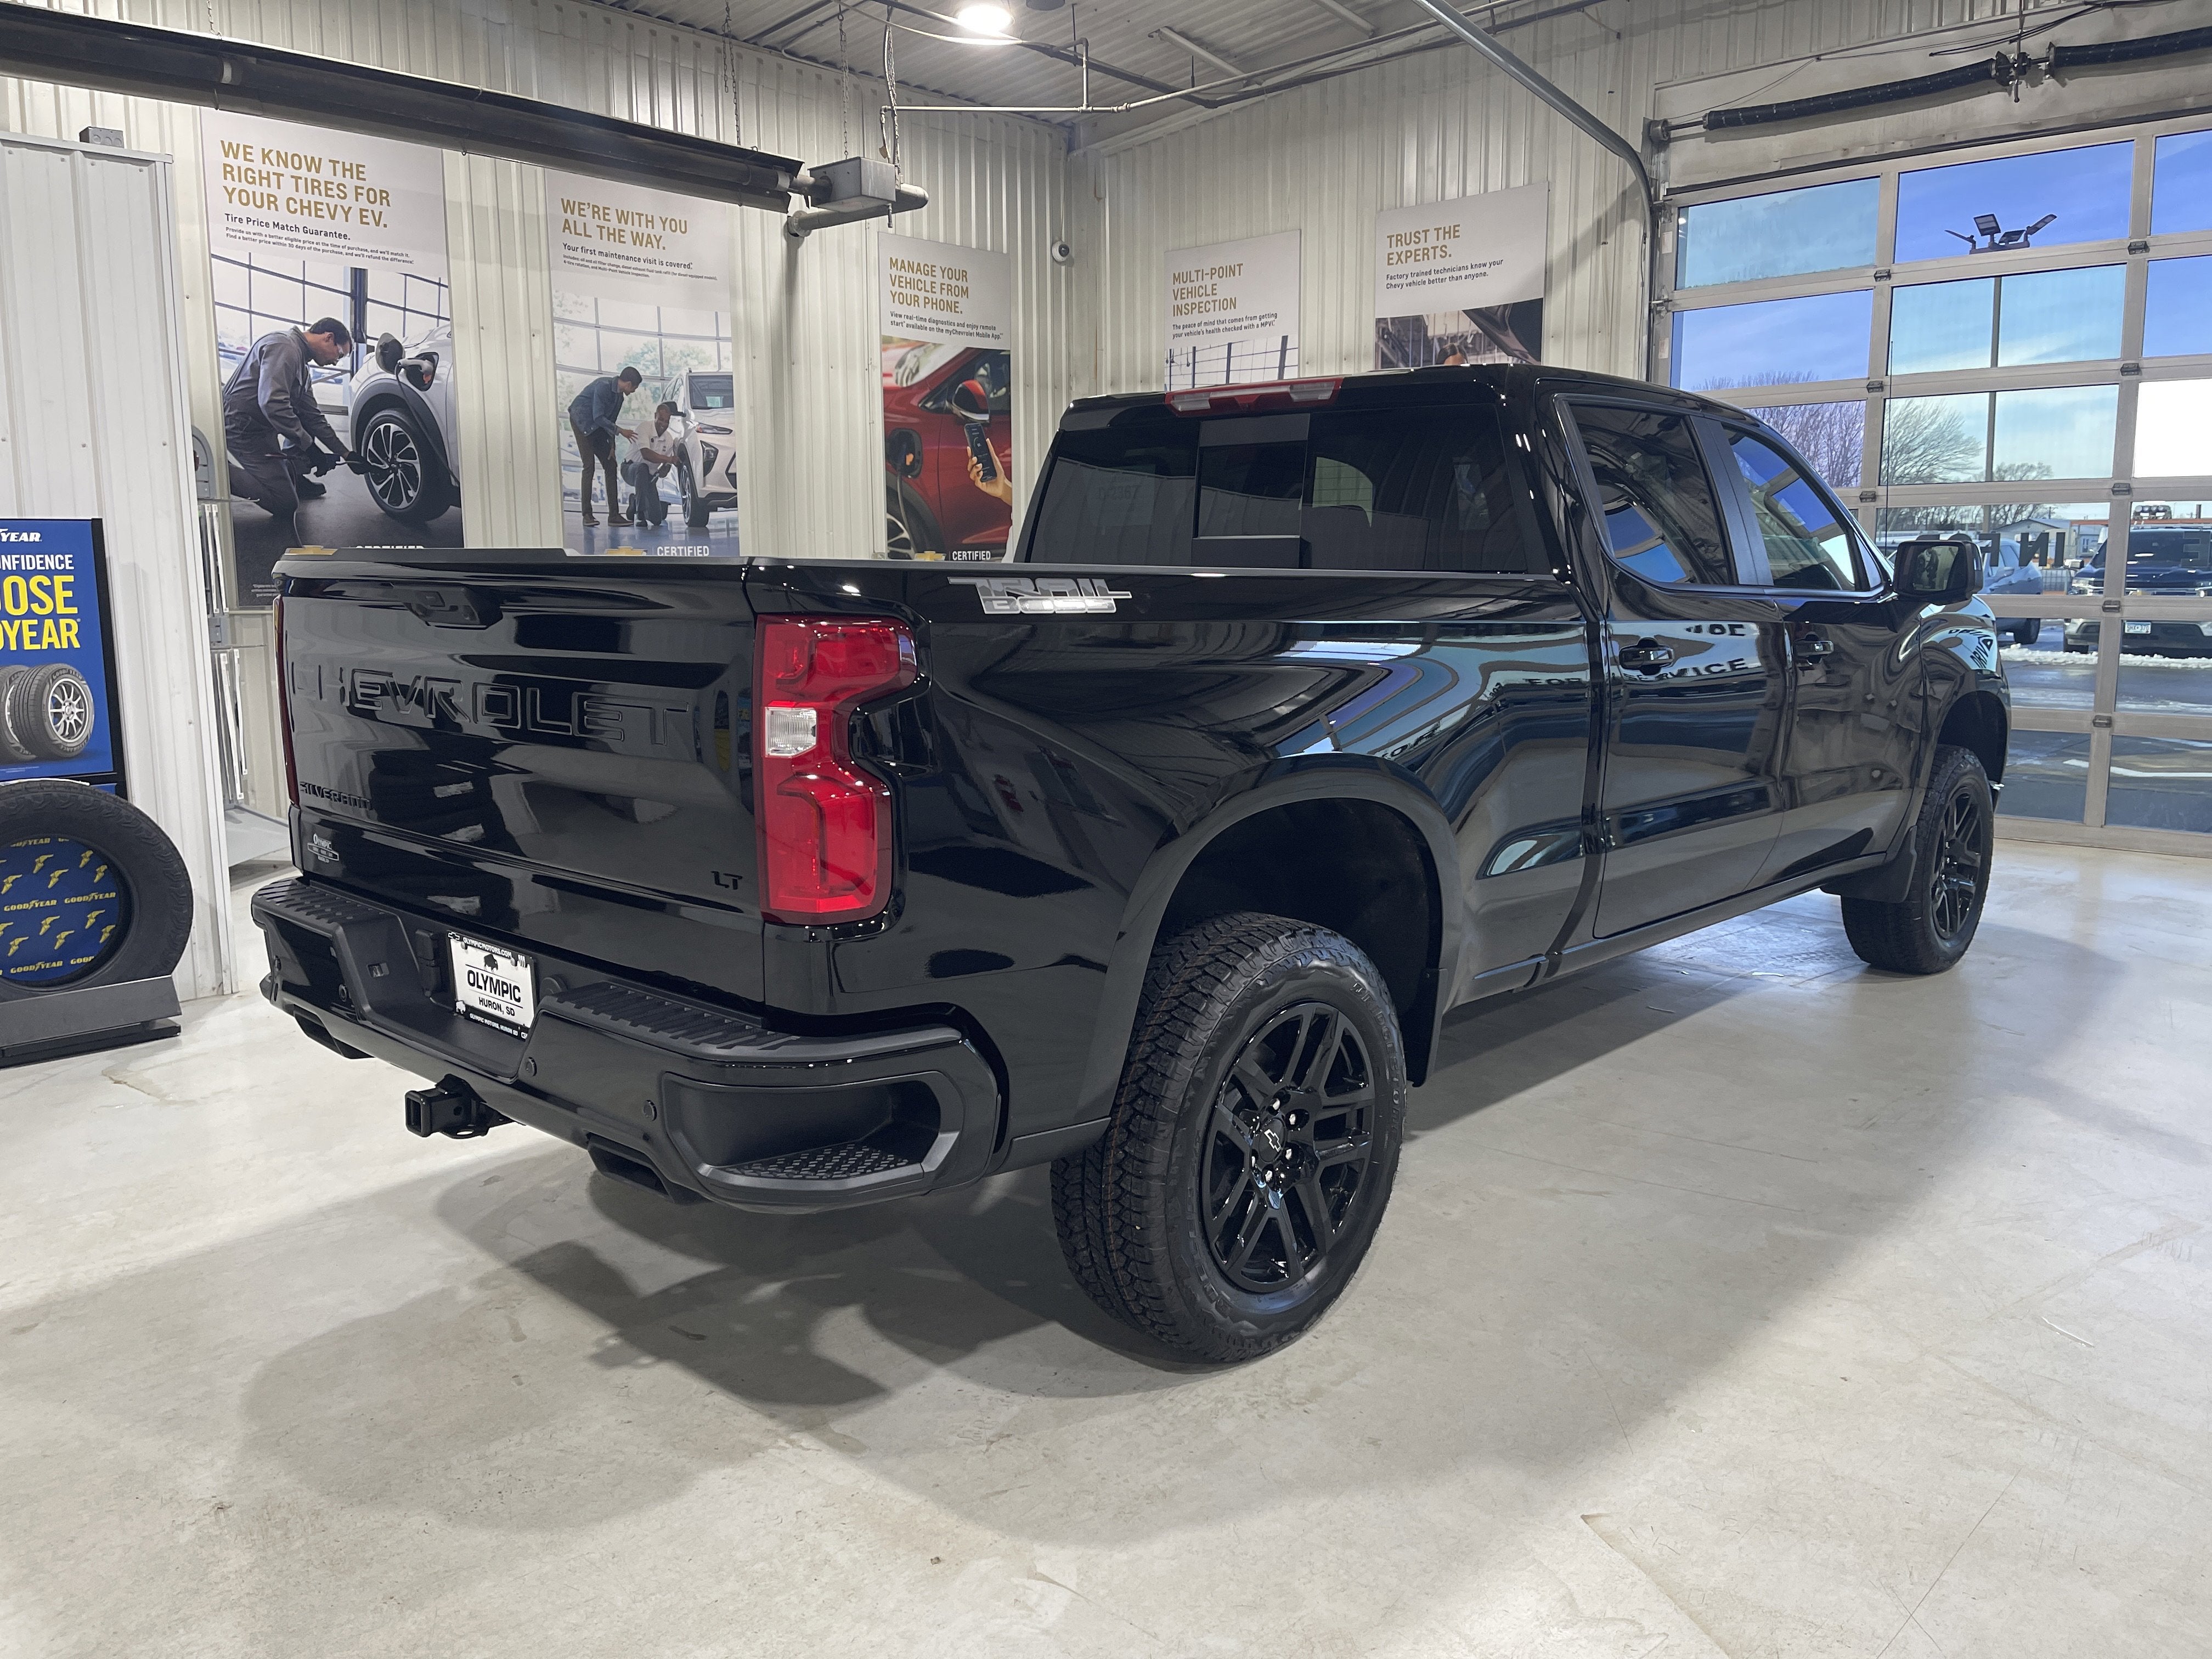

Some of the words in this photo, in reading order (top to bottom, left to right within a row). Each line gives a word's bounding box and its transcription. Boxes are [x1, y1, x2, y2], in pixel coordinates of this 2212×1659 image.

[221, 140, 254, 163] WE
[262, 148, 322, 174] KNOW
[329, 159, 366, 182] THE
[223, 163, 284, 190] RIGHT
[291, 175, 347, 201] TIRES
[354, 187, 391, 207] FOR
[223, 185, 279, 212] YOUR
[286, 196, 352, 223] CHEVY
[359, 208, 387, 228] EV.
[561, 198, 611, 222] WE'RE
[615, 208, 654, 229] WITH
[659, 216, 687, 234] YOU
[224, 213, 243, 223] Tire
[247, 217, 269, 228] Price
[273, 221, 300, 233] Match
[303, 226, 350, 240] Guarantee.
[562, 218, 592, 238] ALL
[596, 224, 626, 244] THE
[630, 231, 665, 250] WAY.
[1387, 229, 1430, 248] TRUST
[1434, 224, 1460, 241] THE
[563, 242, 579, 252] Your
[581, 246, 596, 256] first
[598, 251, 641, 262] maintenance
[1387, 245, 1452, 266] EXPERTS.
[889, 257, 936, 278] MANAGE
[940, 266, 968, 283] YOUR
[1173, 263, 1243, 285] MULTI-POINT
[1410, 269, 1432, 278] trained
[1434, 264, 1469, 274] technicians
[1489, 259, 1504, 268] your
[889, 274, 936, 294] VEHICLE
[940, 283, 969, 299] FROM
[1386, 281, 1404, 289] Chevy
[1406, 279, 1426, 287] vehicle
[1428, 276, 1447, 285] better
[1465, 272, 1488, 280] anyone.
[890, 290, 919, 308] YOUR
[924, 296, 962, 314] PHONE.
[1173, 283, 1217, 301] VEHICLE
[1173, 297, 1237, 317] INSPECTION
[1259, 313, 1277, 321] getting
[904, 314, 927, 323] real-time
[928, 317, 955, 326] diagnostics
[945, 329, 974, 337] myChevrolet
[657, 545, 709, 557] CERTIFIED
[952, 550, 991, 561] CERTIFIED
[0, 554, 75, 571] NFIDENCE
[0, 574, 78, 616] OSE
[947, 577, 1132, 599] TRAIL
[291, 661, 690, 746] CHEVROLET
[710, 871, 743, 891] LT
[4, 899, 57, 912] GOODYEAR
[64, 892, 116, 904] GOODYEAR
[463, 936, 512, 958] OLYMPICMOTORS.COM
[10, 961, 63, 974] GOODYEAR
[467, 969, 521, 1003] OLYMPIC
[478, 996, 504, 1015] HURON,
[506, 1006, 515, 1017] SD
